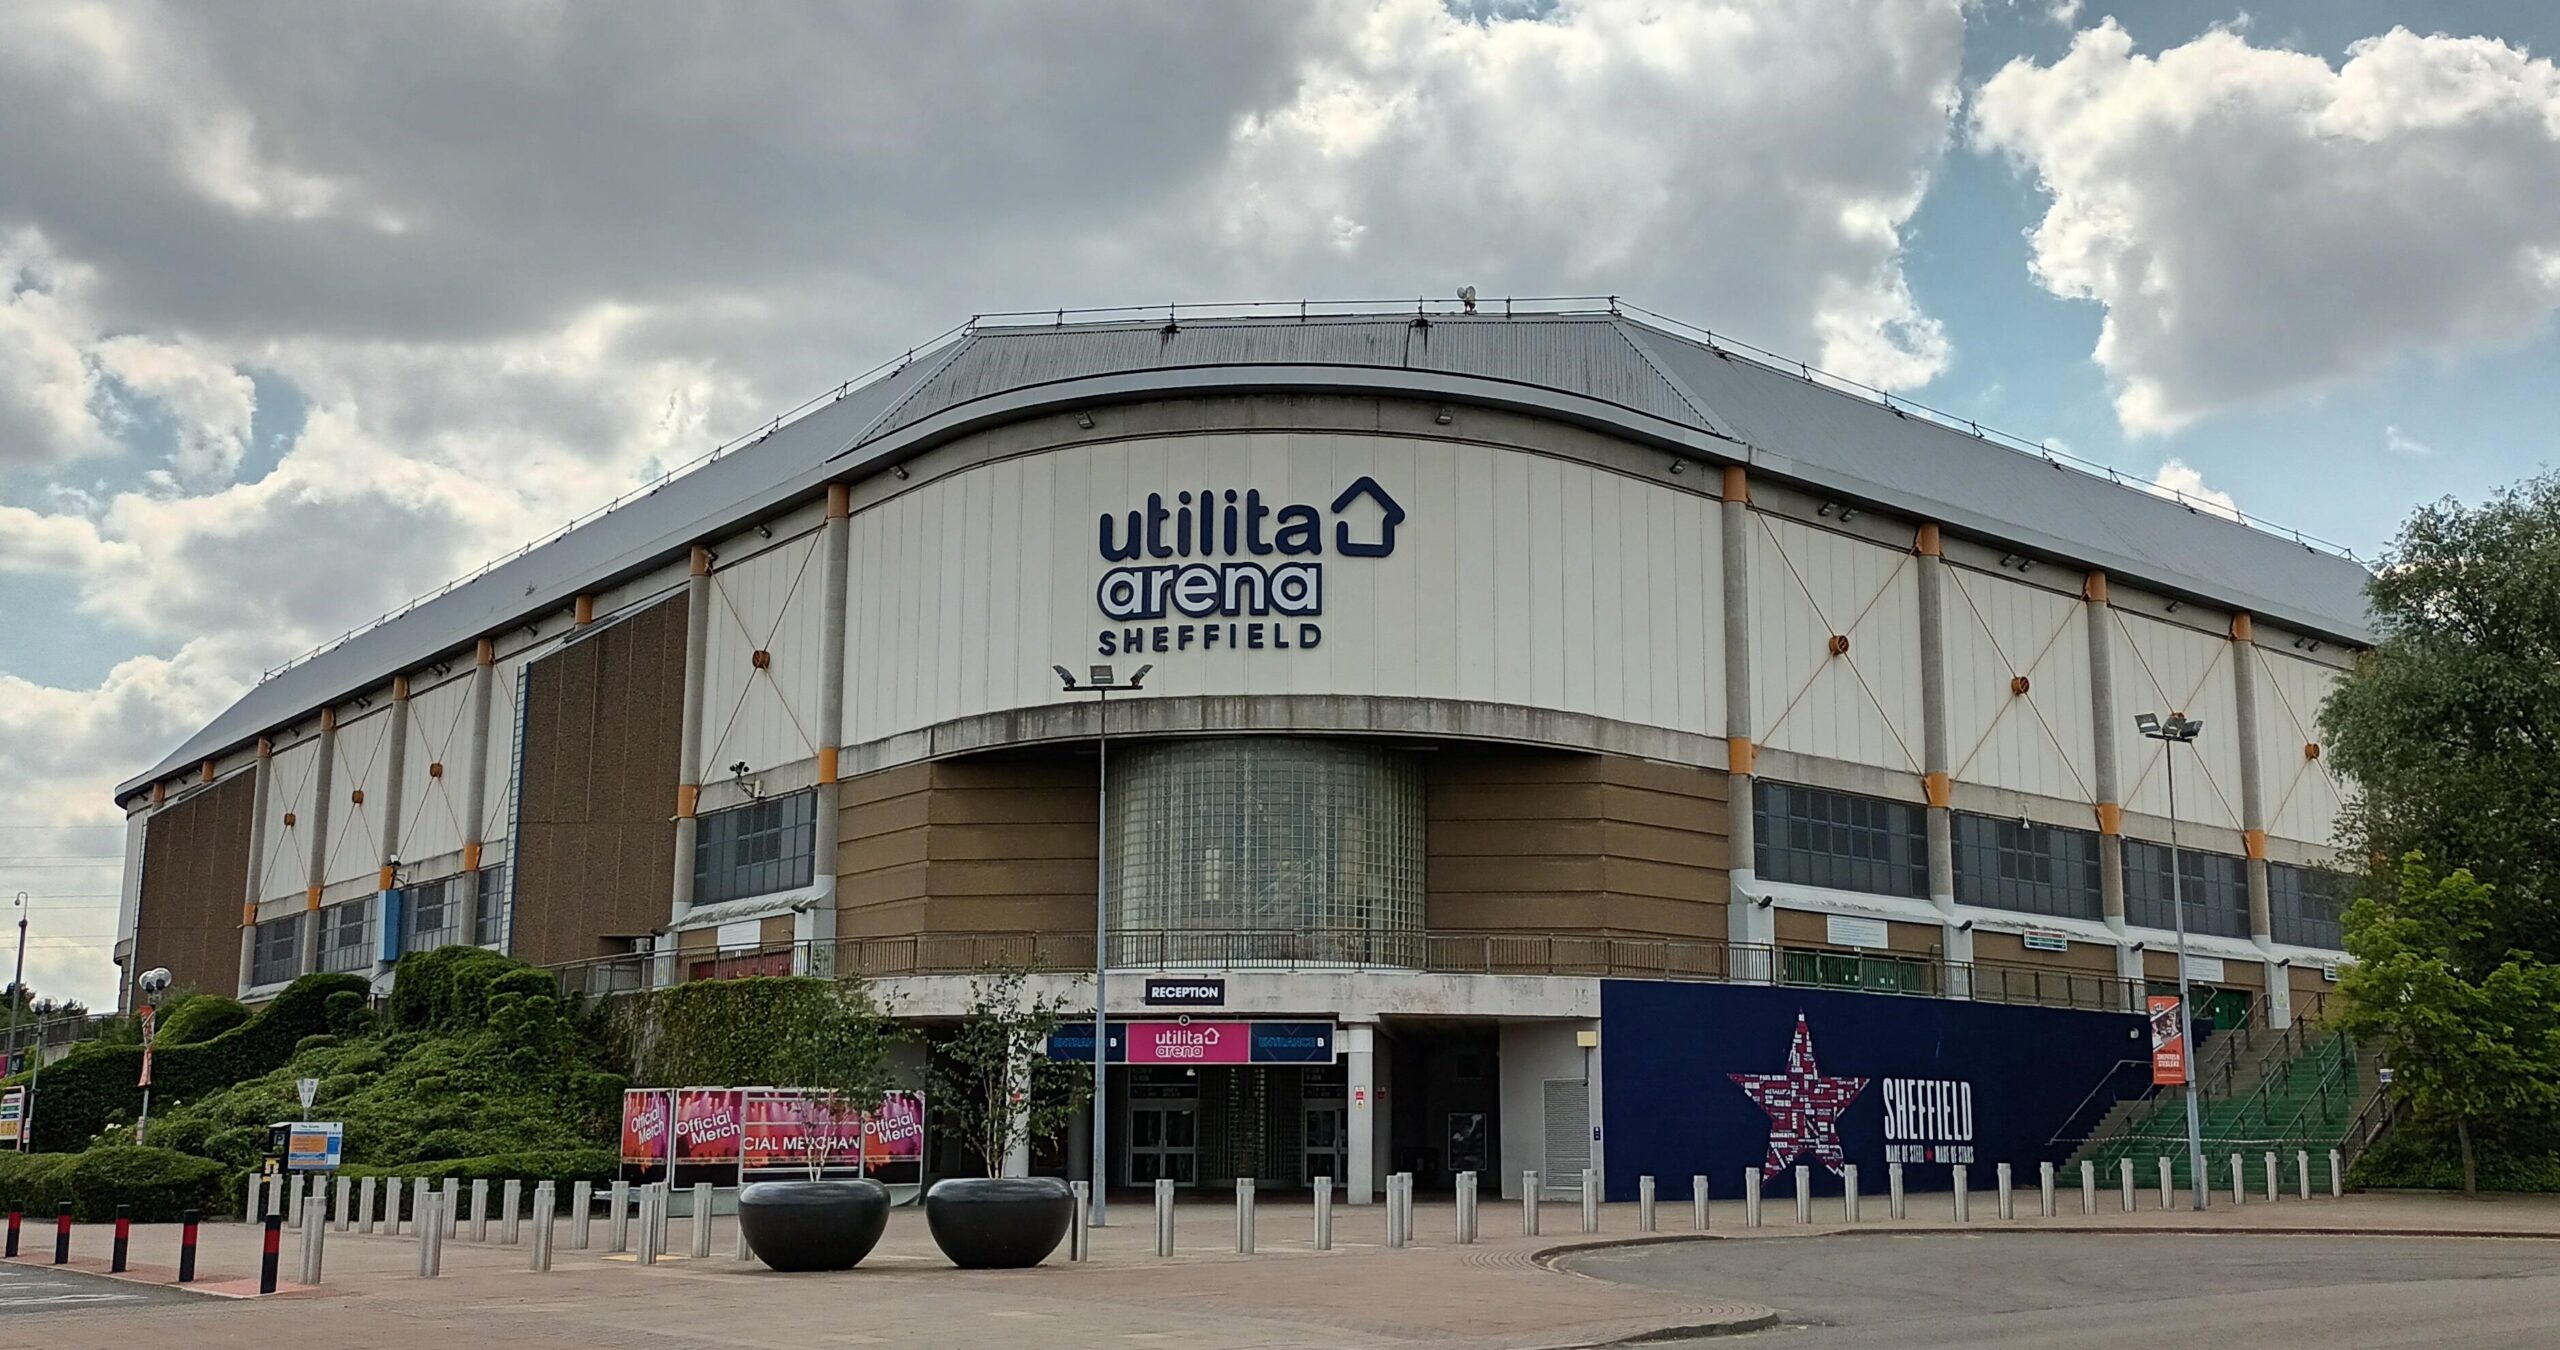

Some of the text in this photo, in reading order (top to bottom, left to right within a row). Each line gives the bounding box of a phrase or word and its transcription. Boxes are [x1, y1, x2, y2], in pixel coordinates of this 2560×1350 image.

[1100, 489, 1322, 562] utilita
[1097, 562, 1322, 621] arena
[1099, 623, 1322, 656] SHEFFIELD
[1151, 986, 1218, 998] RECEPTION
[1110, 1037, 1117, 1047] B
[1155, 1030, 1204, 1045] utilita
[1258, 1037, 1325, 1048] ENTRANCE B
[1155, 1045, 1204, 1058] arena
[631, 1102, 660, 1133] Official
[1882, 1078, 1973, 1141] SHEFFIELD
[638, 1119, 665, 1145] Merch
[676, 1110, 731, 1136] Official
[691, 1122, 741, 1145] Merch
[864, 1112, 914, 1135] Official
[878, 1123, 923, 1144] Merch
[743, 1137, 779, 1150] CIAL
[1886, 1145, 1901, 1163] MADE
[1902, 1145, 1909, 1163] OF
[1910, 1145, 1925, 1163] STEEL
[1935, 1145, 1950, 1163] MADE
[1951, 1146, 1957, 1163] OF
